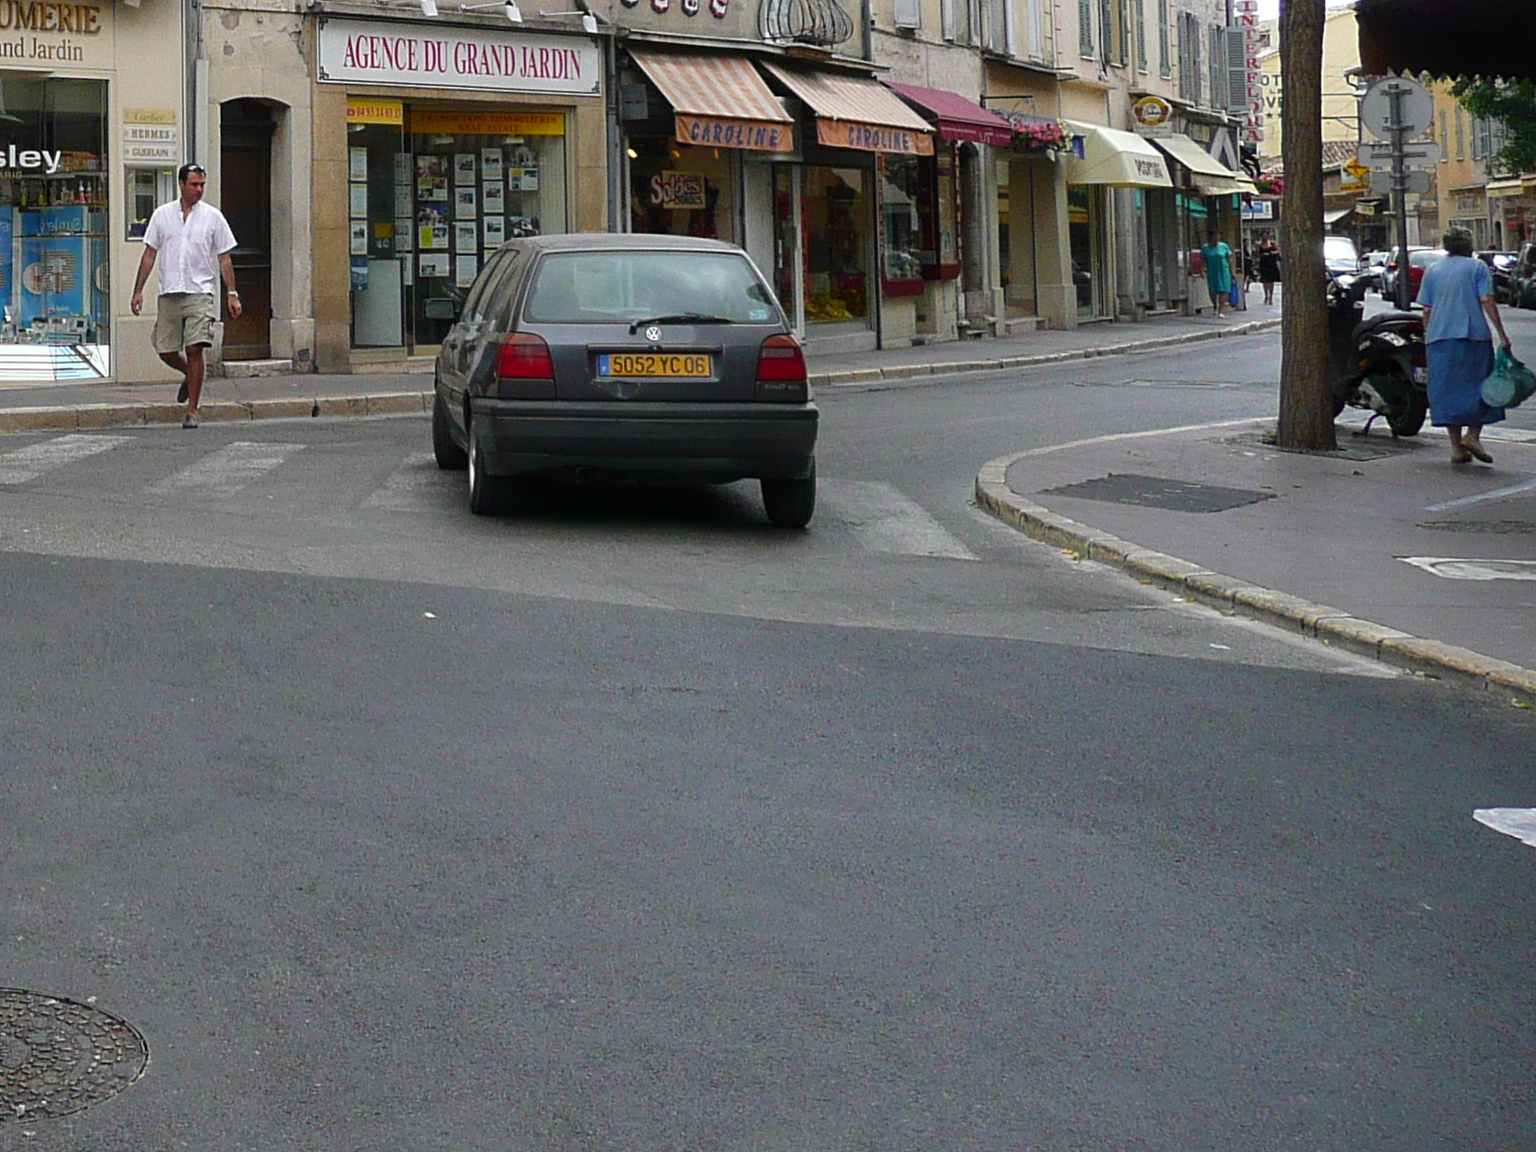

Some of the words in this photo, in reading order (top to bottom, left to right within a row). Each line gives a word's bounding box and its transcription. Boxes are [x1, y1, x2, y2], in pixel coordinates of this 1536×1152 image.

[29, 37, 84, 61] Jardin
[343, 34, 419, 72] AGENCE
[424, 40, 449, 74] DU
[454, 41, 515, 77] GRAND
[520, 46, 582, 80] JARDIN
[132, 129, 170, 139] HERMES
[691, 122, 779, 147] CAROLINE
[848, 126, 910, 151] CAROLINE
[651, 174, 701, 204] Soldes
[613, 356, 656, 374] 5052
[659, 356, 681, 374] YC
[684, 357, 706, 374] 06
